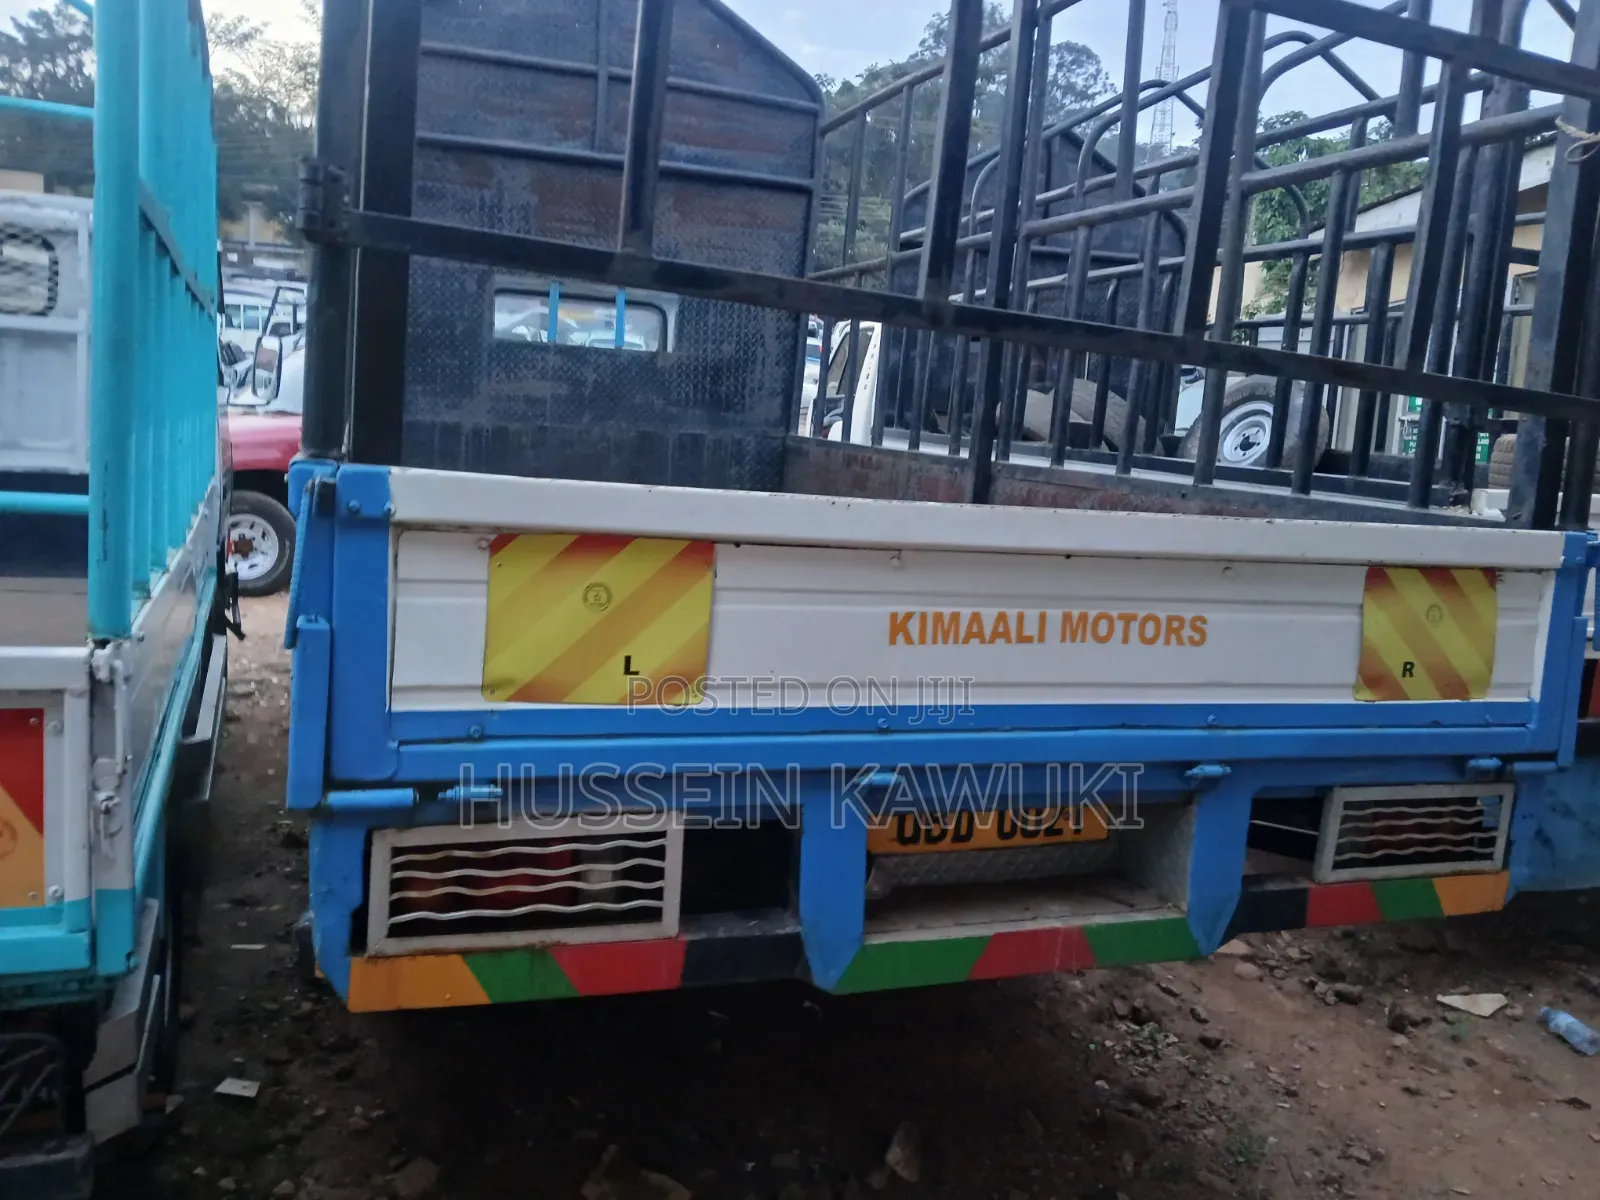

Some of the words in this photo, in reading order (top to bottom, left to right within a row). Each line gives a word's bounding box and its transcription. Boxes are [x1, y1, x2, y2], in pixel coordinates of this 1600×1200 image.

[889, 610, 1046, 645] KIMAALI
[1061, 611, 1208, 647] MOTORS
[623, 655, 640, 676] L
[1402, 661, 1415, 678] R
